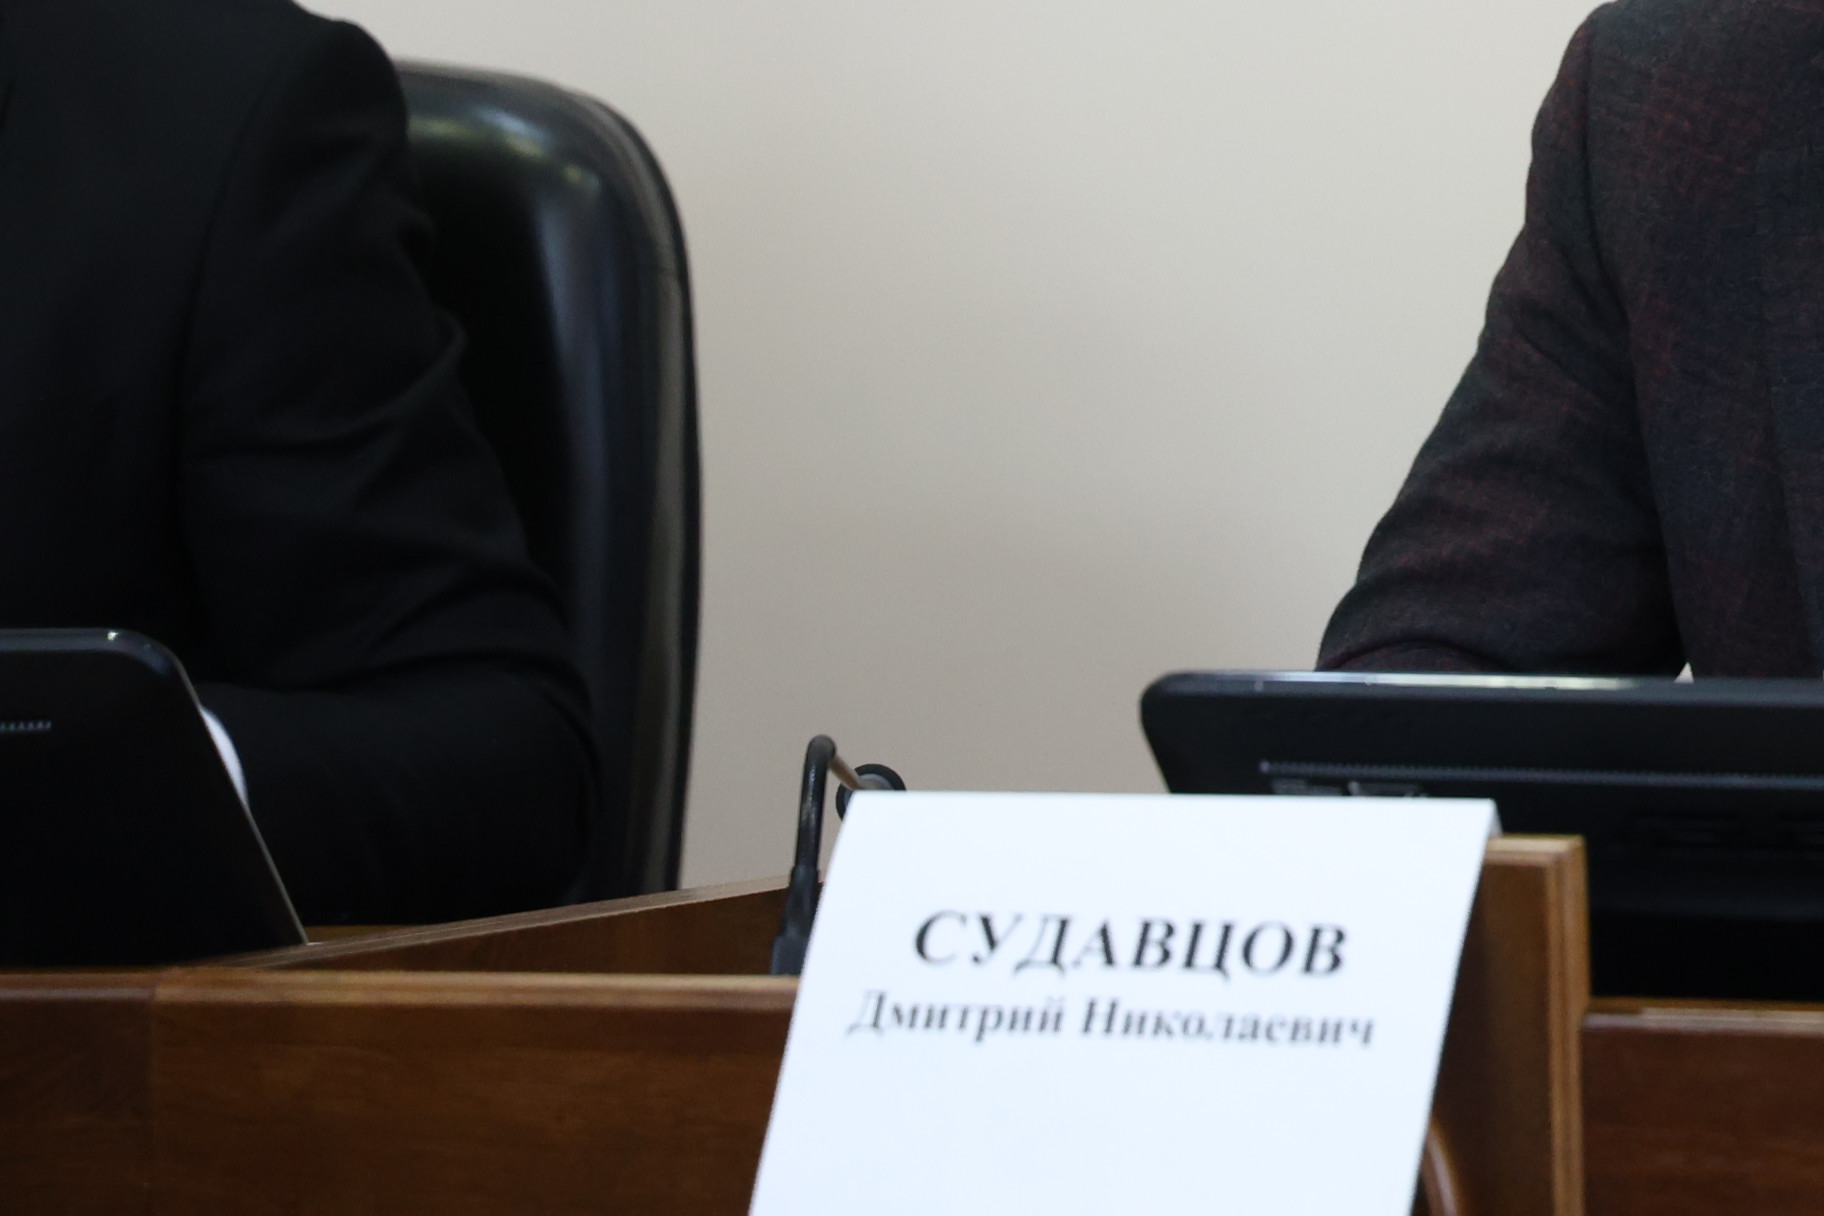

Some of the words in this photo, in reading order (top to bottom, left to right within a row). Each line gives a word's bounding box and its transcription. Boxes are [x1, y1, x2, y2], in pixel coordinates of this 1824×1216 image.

[912, 910, 1347, 980] СУДАВЦОВ
[847, 991, 1064, 1043] Дмитрий
[1081, 997, 1373, 1046] Николаевич
